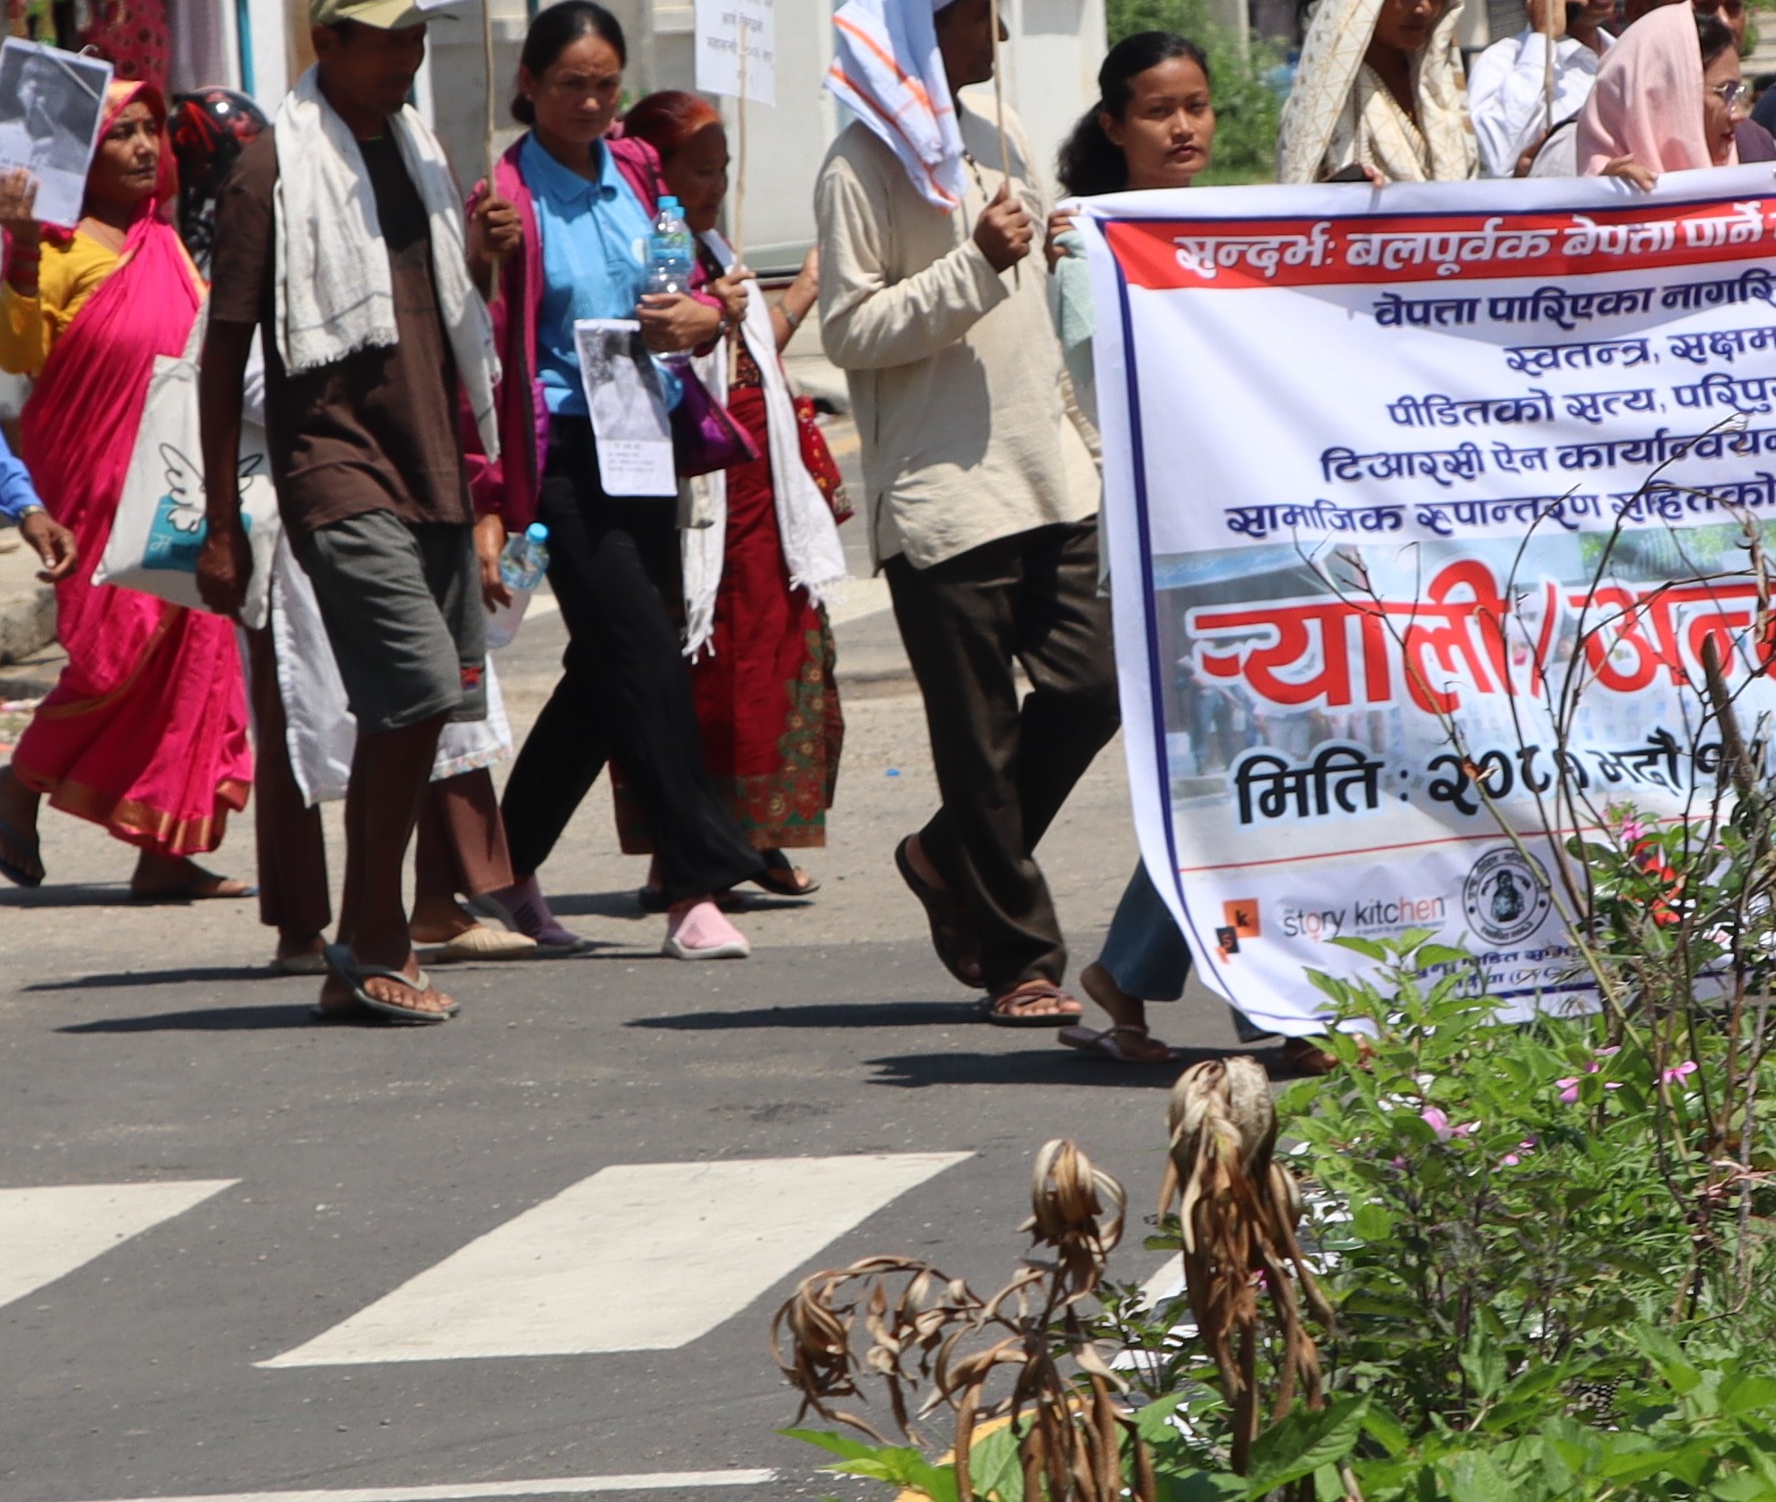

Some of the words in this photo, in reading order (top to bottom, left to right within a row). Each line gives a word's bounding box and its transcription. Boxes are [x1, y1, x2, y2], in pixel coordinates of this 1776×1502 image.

[1346, 218, 1551, 276] बलपूर्वक
[1686, 200, 1765, 250] पार्ने
[1487, 286, 1653, 330] पारिएका
[1386, 387, 1555, 430] पीडितको
[1565, 388, 1668, 425] सत्य,
[1321, 441, 1485, 487] टिआरसी
[1491, 440, 1548, 476] ऐन
[1225, 499, 1404, 539] सामाजिक
[1234, 745, 1385, 826] मिति
[1283, 908, 1346, 939] story
[1354, 895, 1446, 927] kitchen
